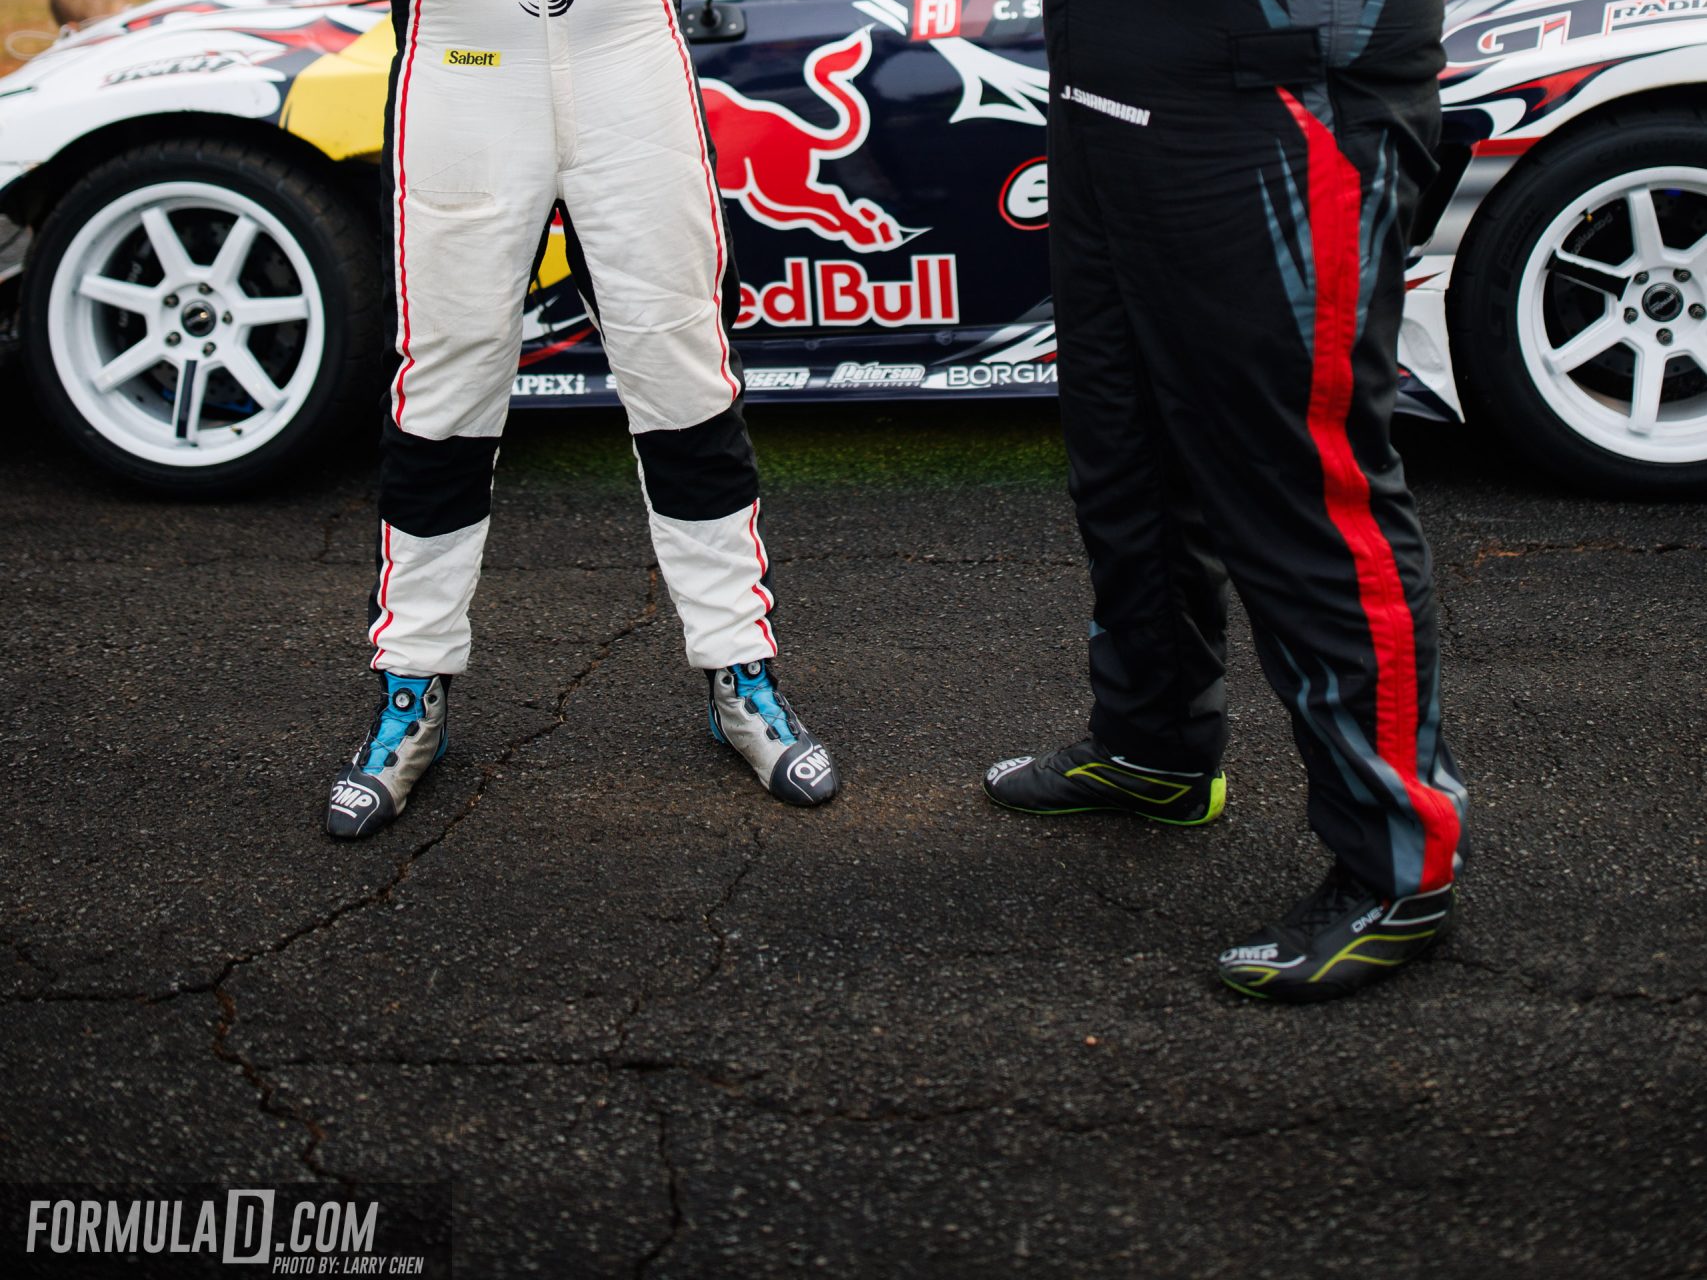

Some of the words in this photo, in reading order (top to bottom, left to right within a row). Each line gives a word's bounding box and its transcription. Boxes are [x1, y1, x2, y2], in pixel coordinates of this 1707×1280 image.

[993, 0, 1018, 20] C.
[449, 50, 494, 66] Sabelt
[815, 254, 959, 326] Bull
[831, 362, 925, 382] Peterson
[332, 785, 373, 811] OMP
[1219, 946, 1279, 963] OMP
